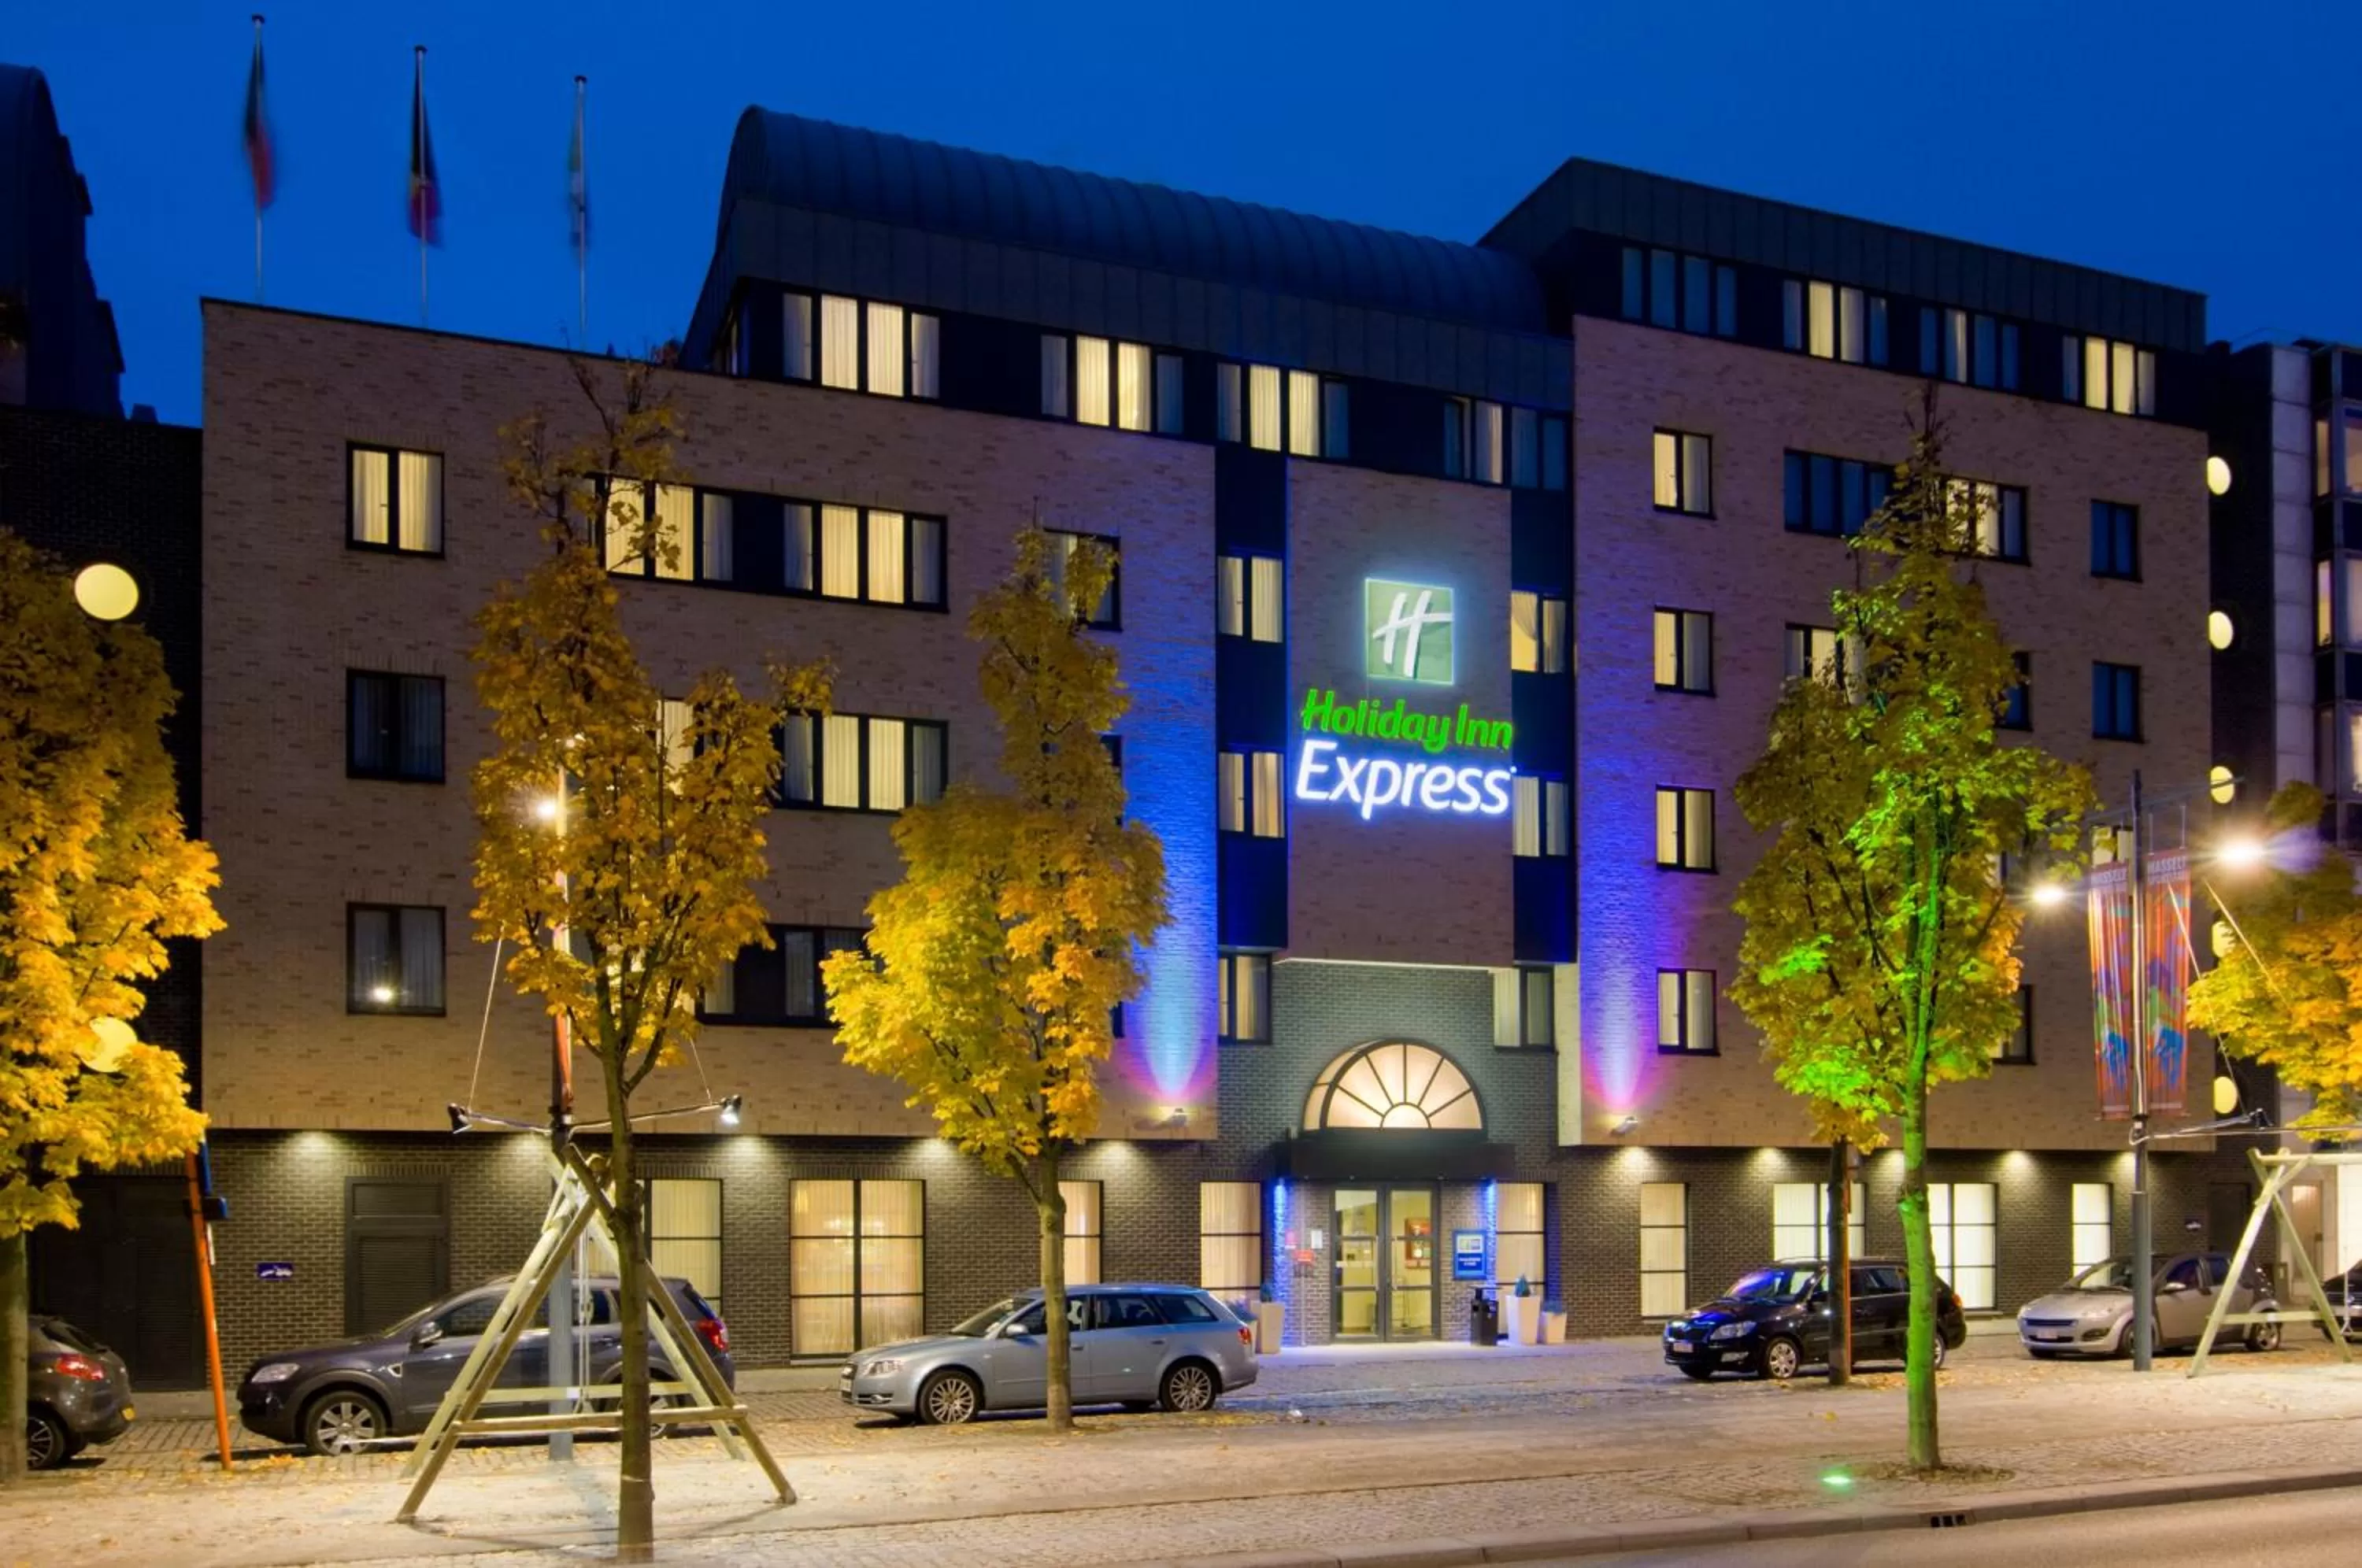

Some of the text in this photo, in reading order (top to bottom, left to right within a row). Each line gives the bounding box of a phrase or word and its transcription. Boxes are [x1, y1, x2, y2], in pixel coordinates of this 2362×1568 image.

[1301, 689, 1513, 753] Holiday Inn
[1295, 738, 1512, 820] Express
